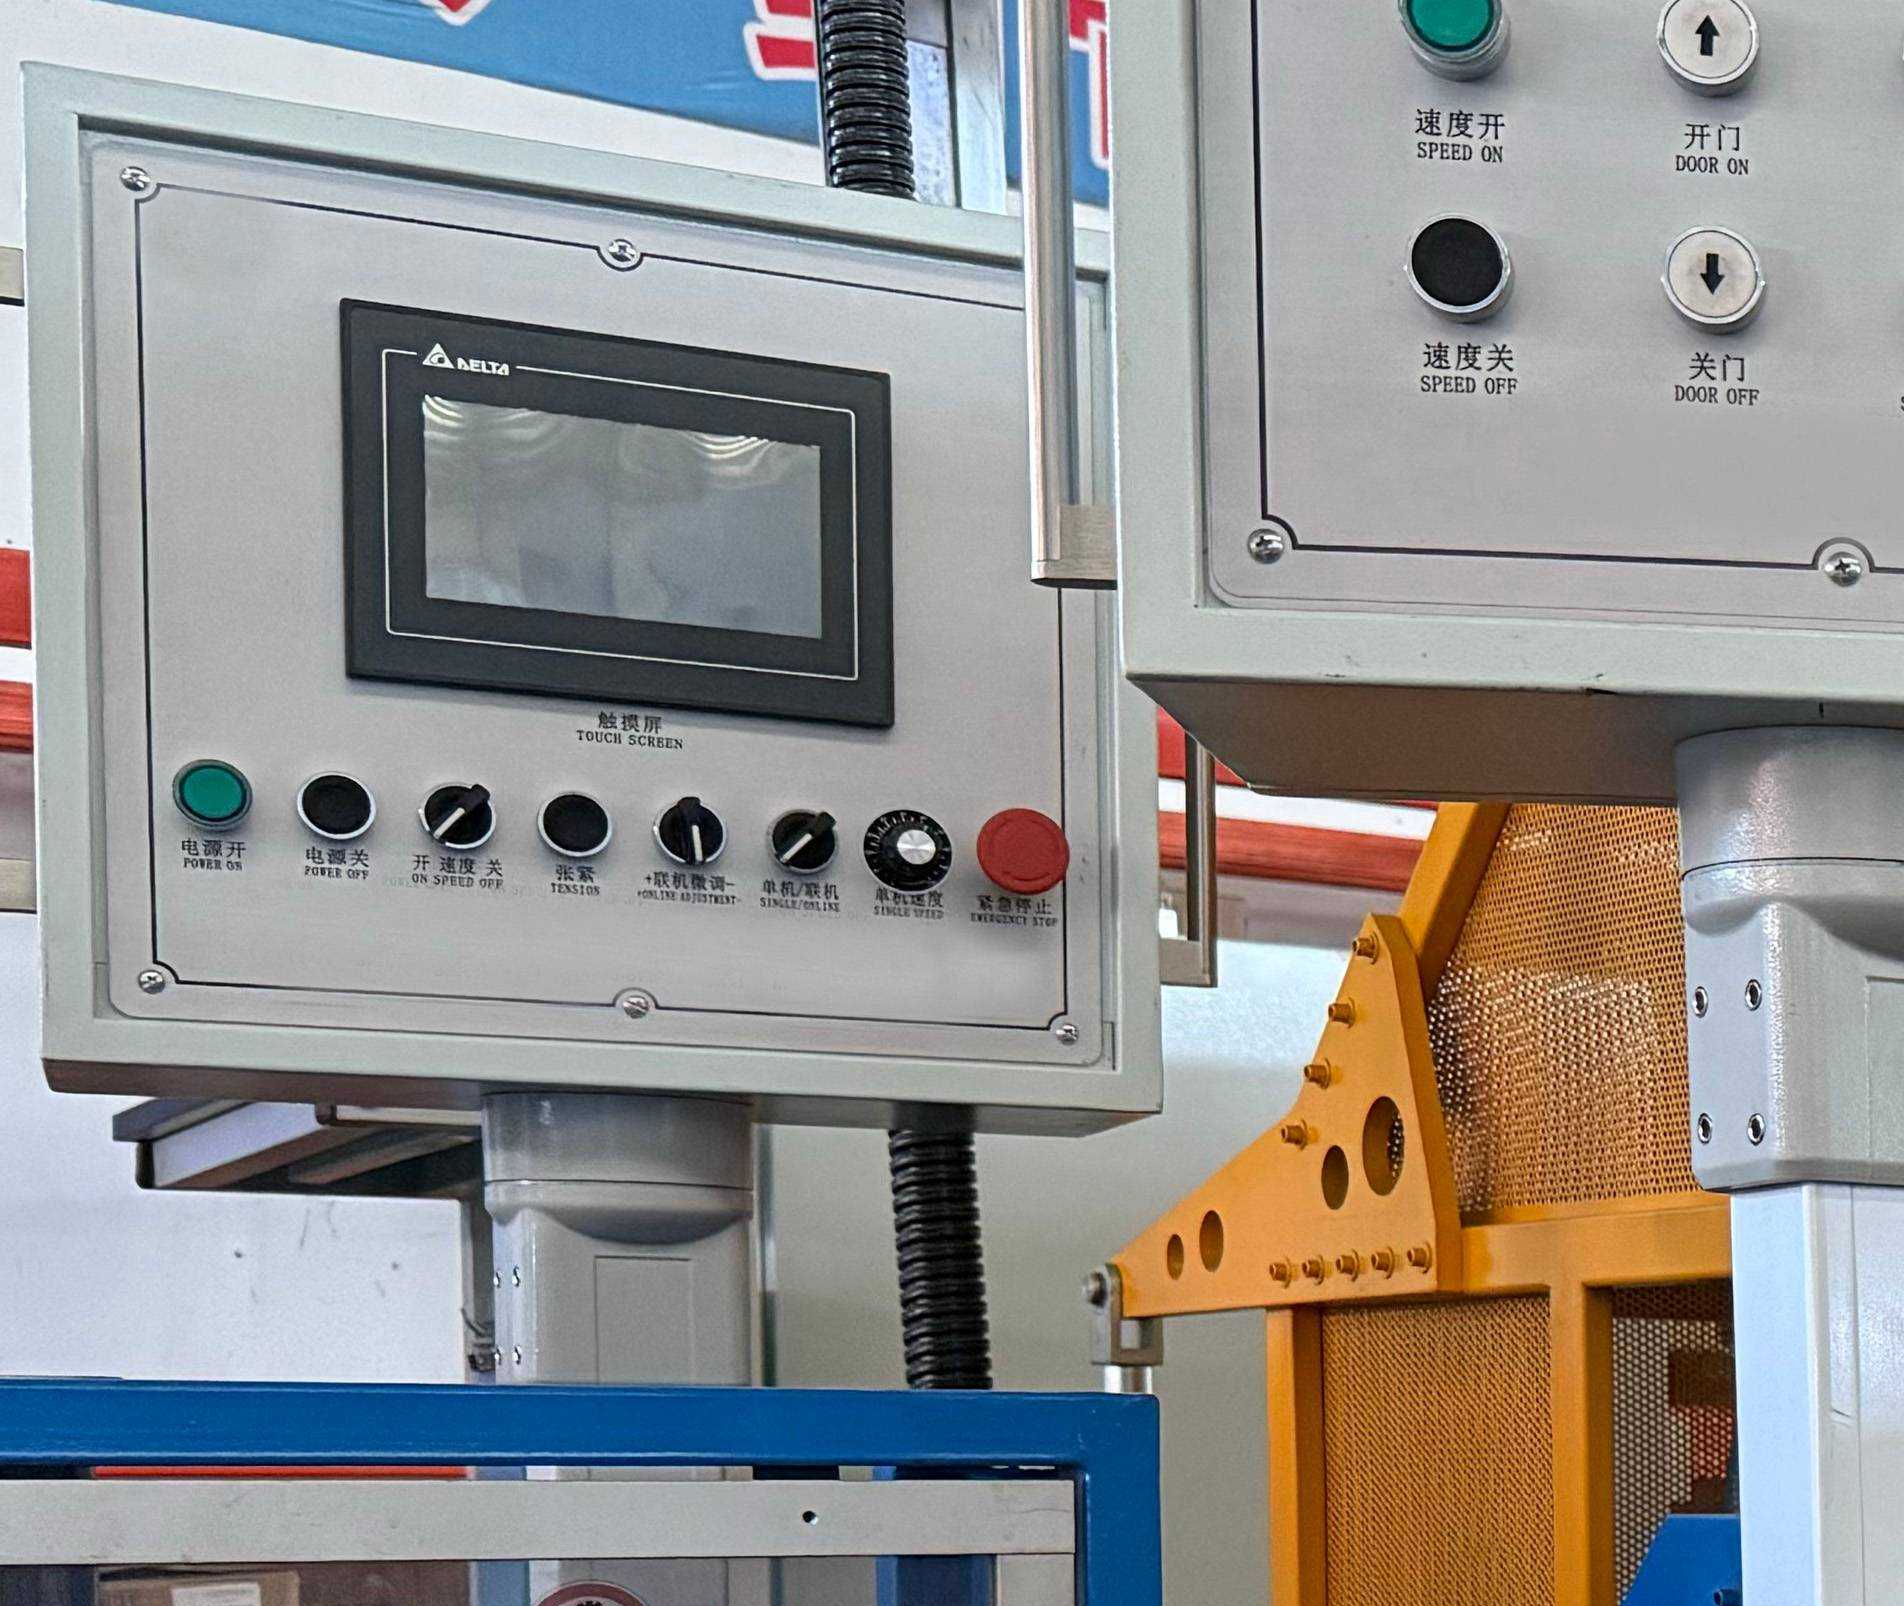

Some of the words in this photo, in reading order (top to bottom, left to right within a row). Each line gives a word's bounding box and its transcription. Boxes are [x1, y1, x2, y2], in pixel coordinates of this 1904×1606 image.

[1415, 108, 1505, 140] 速度开
[1684, 123, 1741, 151] 开门
[1416, 142, 1473, 162] SPEED
[1480, 145, 1503, 163] ON
[1675, 154, 1718, 174] DOOR
[1727, 157, 1749, 175] ON
[457, 357, 510, 376] DELTA
[1422, 342, 1515, 373] 速度关
[1688, 352, 1746, 382] 关门
[1420, 375, 1476, 394] SPEED
[1484, 377, 1519, 395] OFF
[1674, 384, 1718, 404] DOOR
[1726, 387, 1760, 406] OFF
[598, 710, 662, 734] 触摸屏
[576, 729, 622, 745] TOUCH
[628, 734, 684, 750] SCREEN
[181, 838, 246, 860] 电源开
[305, 846, 369, 868] 电源关
[183, 858, 222, 871] POWER
[226, 860, 243, 872] ON
[304, 865, 342, 879] POWER
[347, 867, 370, 881] OFF
[412, 854, 430, 871] 开
[439, 856, 477, 876] 速度
[486, 858, 504, 877] 关
[555, 864, 598, 883] 张紧
[412, 873, 428, 885] ON
[433, 874, 474, 888] SPEED
[479, 877, 504, 890] OFF
[550, 883, 601, 897] TENSION
[977, 894, 1053, 916] 紧急停止
[1031, 915, 1059, 928] STOP
